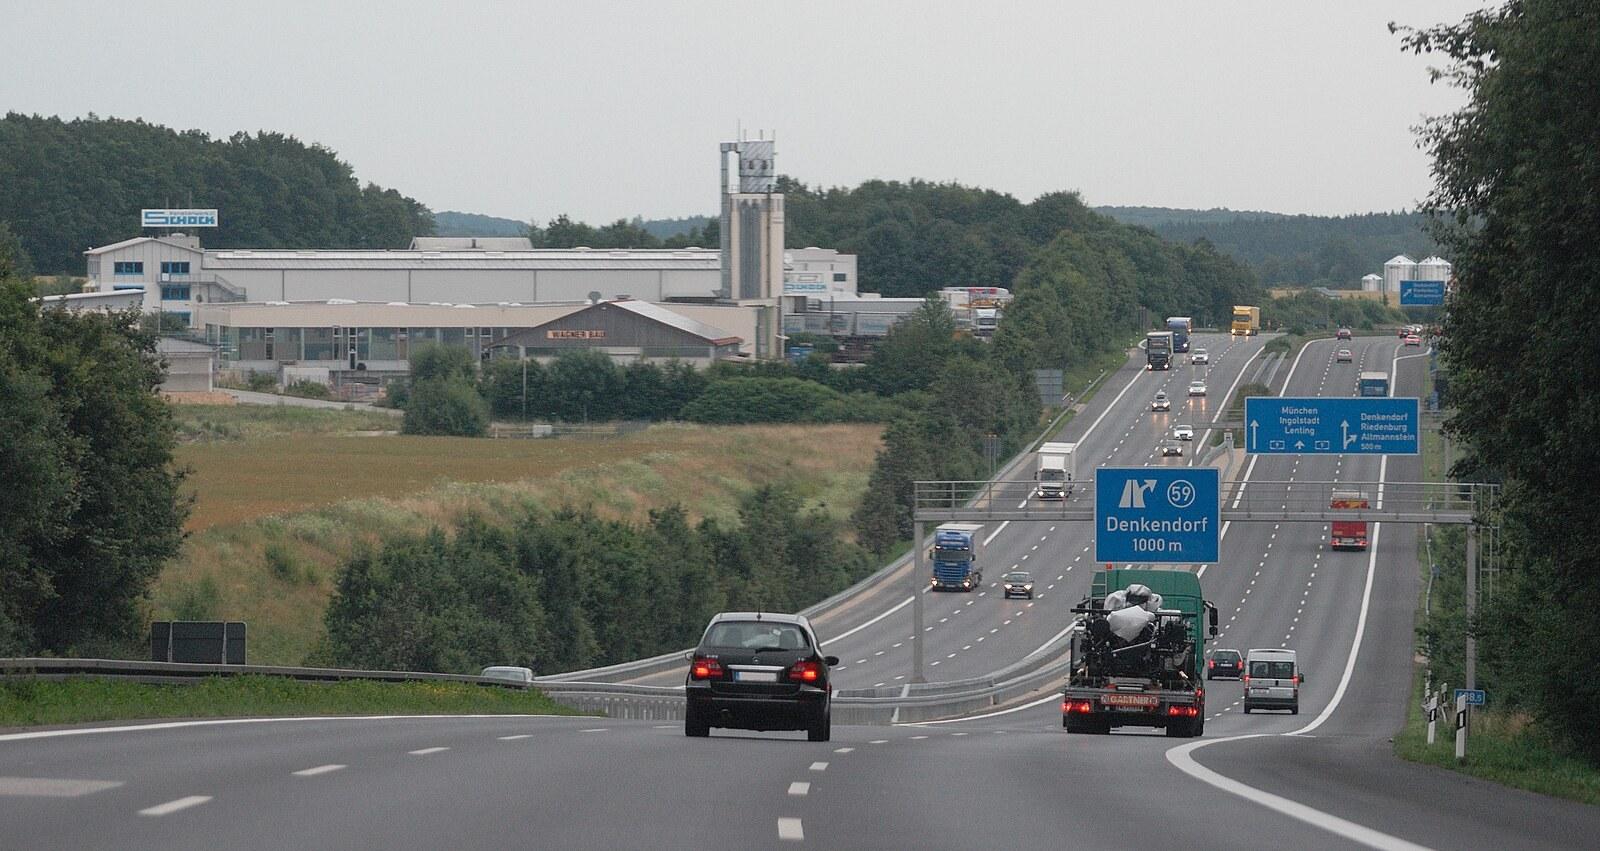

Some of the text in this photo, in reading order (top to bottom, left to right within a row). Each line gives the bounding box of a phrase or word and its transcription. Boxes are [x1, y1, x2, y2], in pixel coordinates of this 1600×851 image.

[1281, 407, 1318, 415] München
[1279, 416, 1320, 426] Ingolstadt
[1360, 412, 1408, 421] Denkendorf
[1284, 426, 1315, 436] Lenting
[1360, 423, 1408, 432] Riedenburg
[1361, 433, 1415, 441] Altmannstein
[1171, 486, 1191, 502] 59
[1106, 516, 1208, 532] Denkendorf
[1133, 538, 1182, 552] 1000 m
